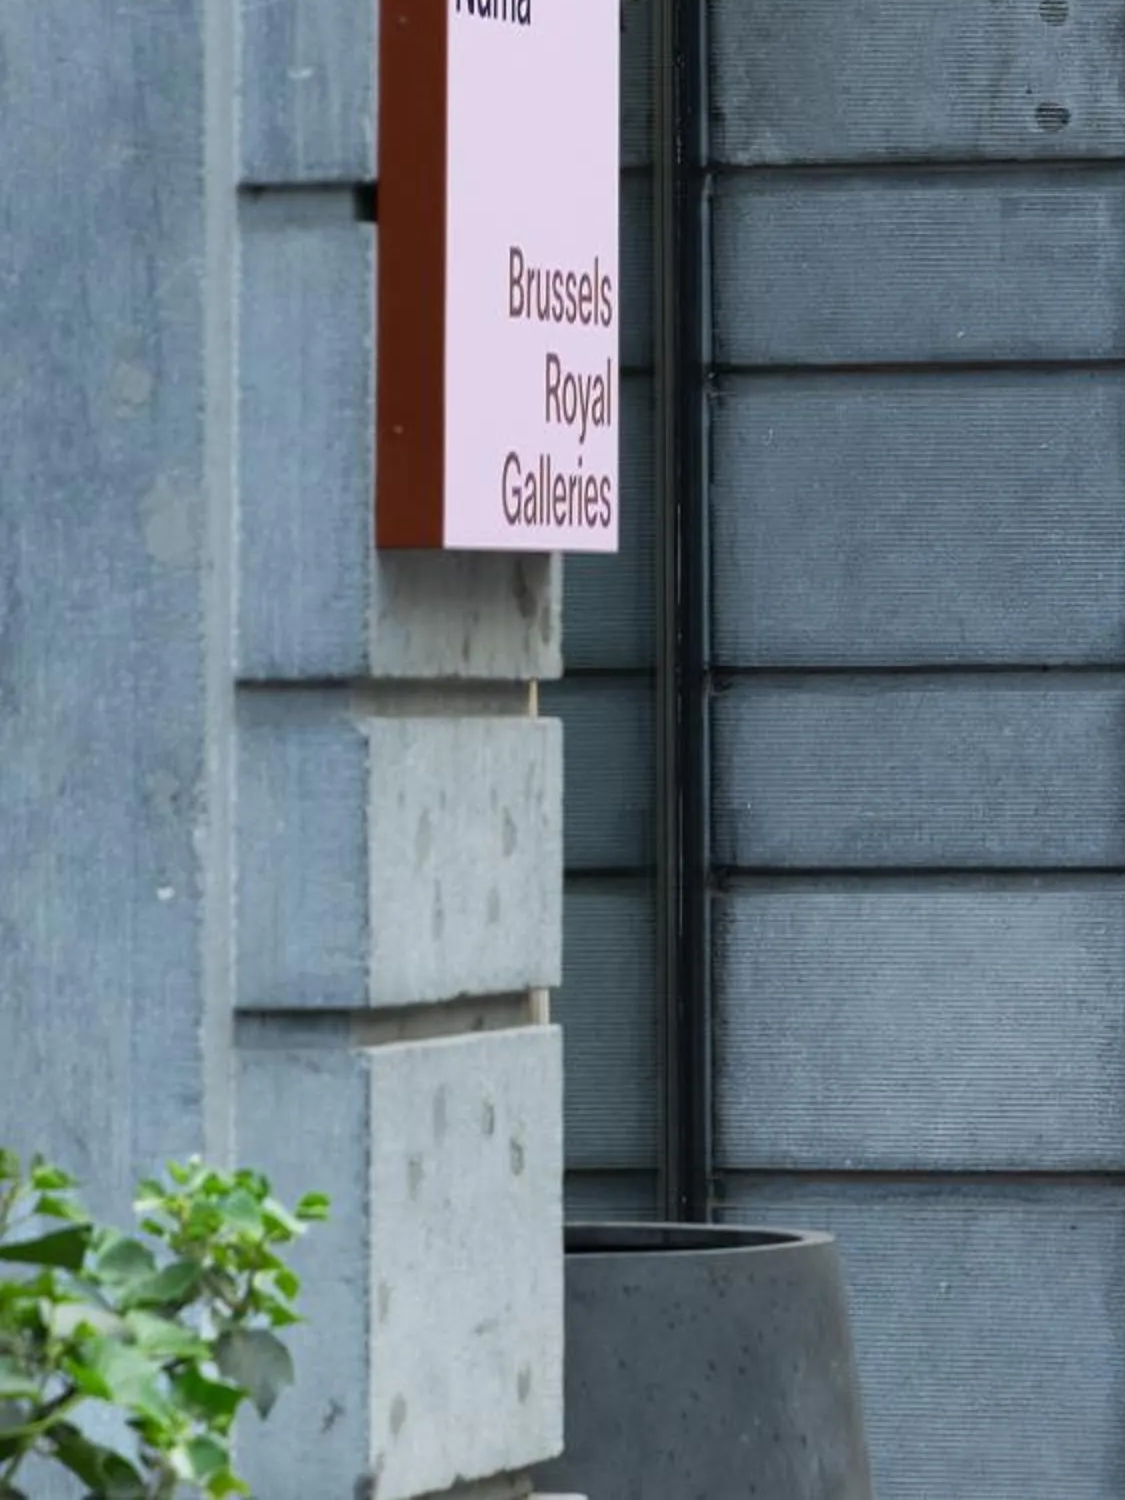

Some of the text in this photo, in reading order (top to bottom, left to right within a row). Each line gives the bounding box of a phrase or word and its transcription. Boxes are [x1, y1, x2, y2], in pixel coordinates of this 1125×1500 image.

[509, 246, 613, 327] Brussels
[545, 352, 612, 444] Royal
[501, 452, 612, 529] Galleries
